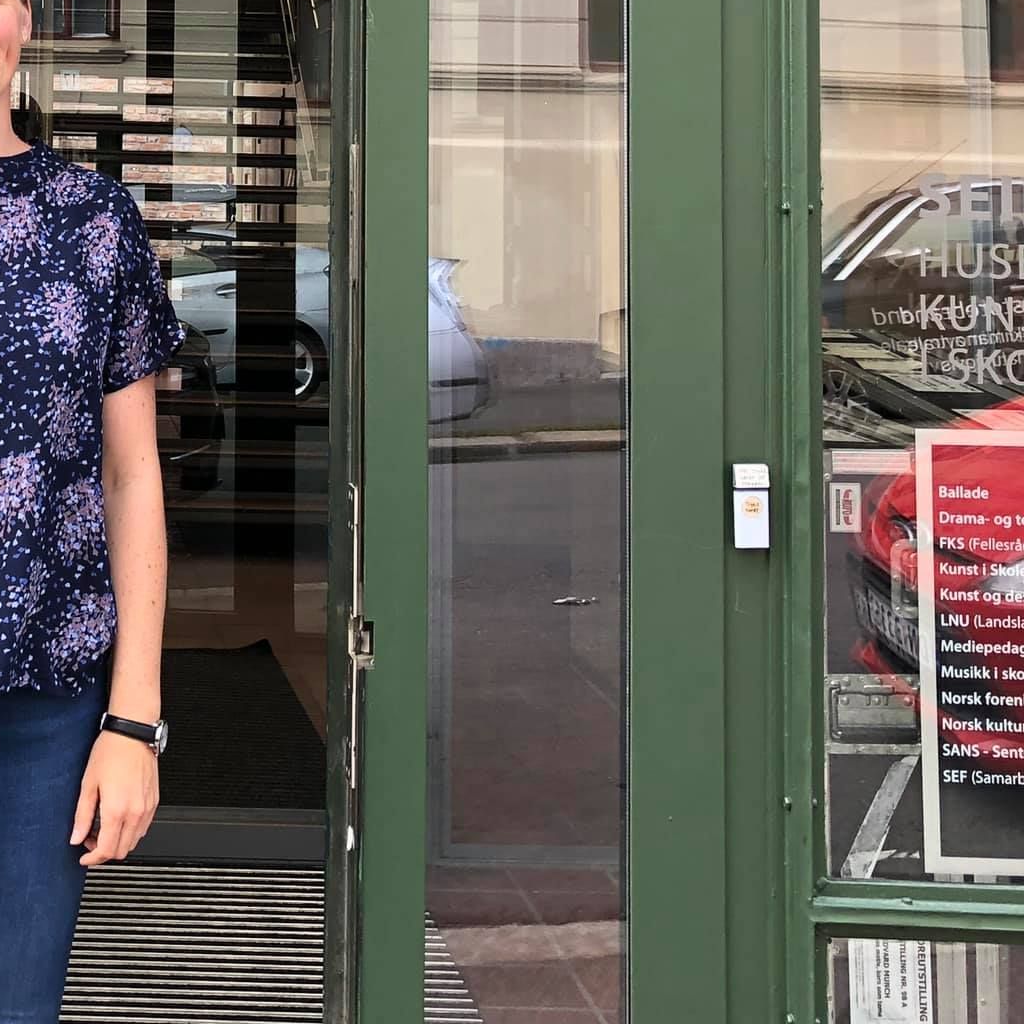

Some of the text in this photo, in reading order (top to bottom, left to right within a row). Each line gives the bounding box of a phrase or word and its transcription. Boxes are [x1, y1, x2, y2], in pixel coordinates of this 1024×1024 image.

[938, 486, 989, 499] Ballade
[939, 511, 990, 525] Drama-
[993, 516, 1012, 528] og
[939, 537, 1024, 552] FKS (Fellesrå
[939, 562, 979, 576] Kunst
[982, 563, 986, 576] i
[940, 588, 1024, 605] Kunst og de
[940, 614, 969, 627] LNU
[941, 665, 1024, 680] Musikk i sko
[941, 691, 982, 705] Norsk
[942, 718, 982, 731] Norsk
[942, 744, 980, 757] SANS
[992, 745, 1024, 759] Sent
[943, 770, 1024, 785] SEF (Samarb
